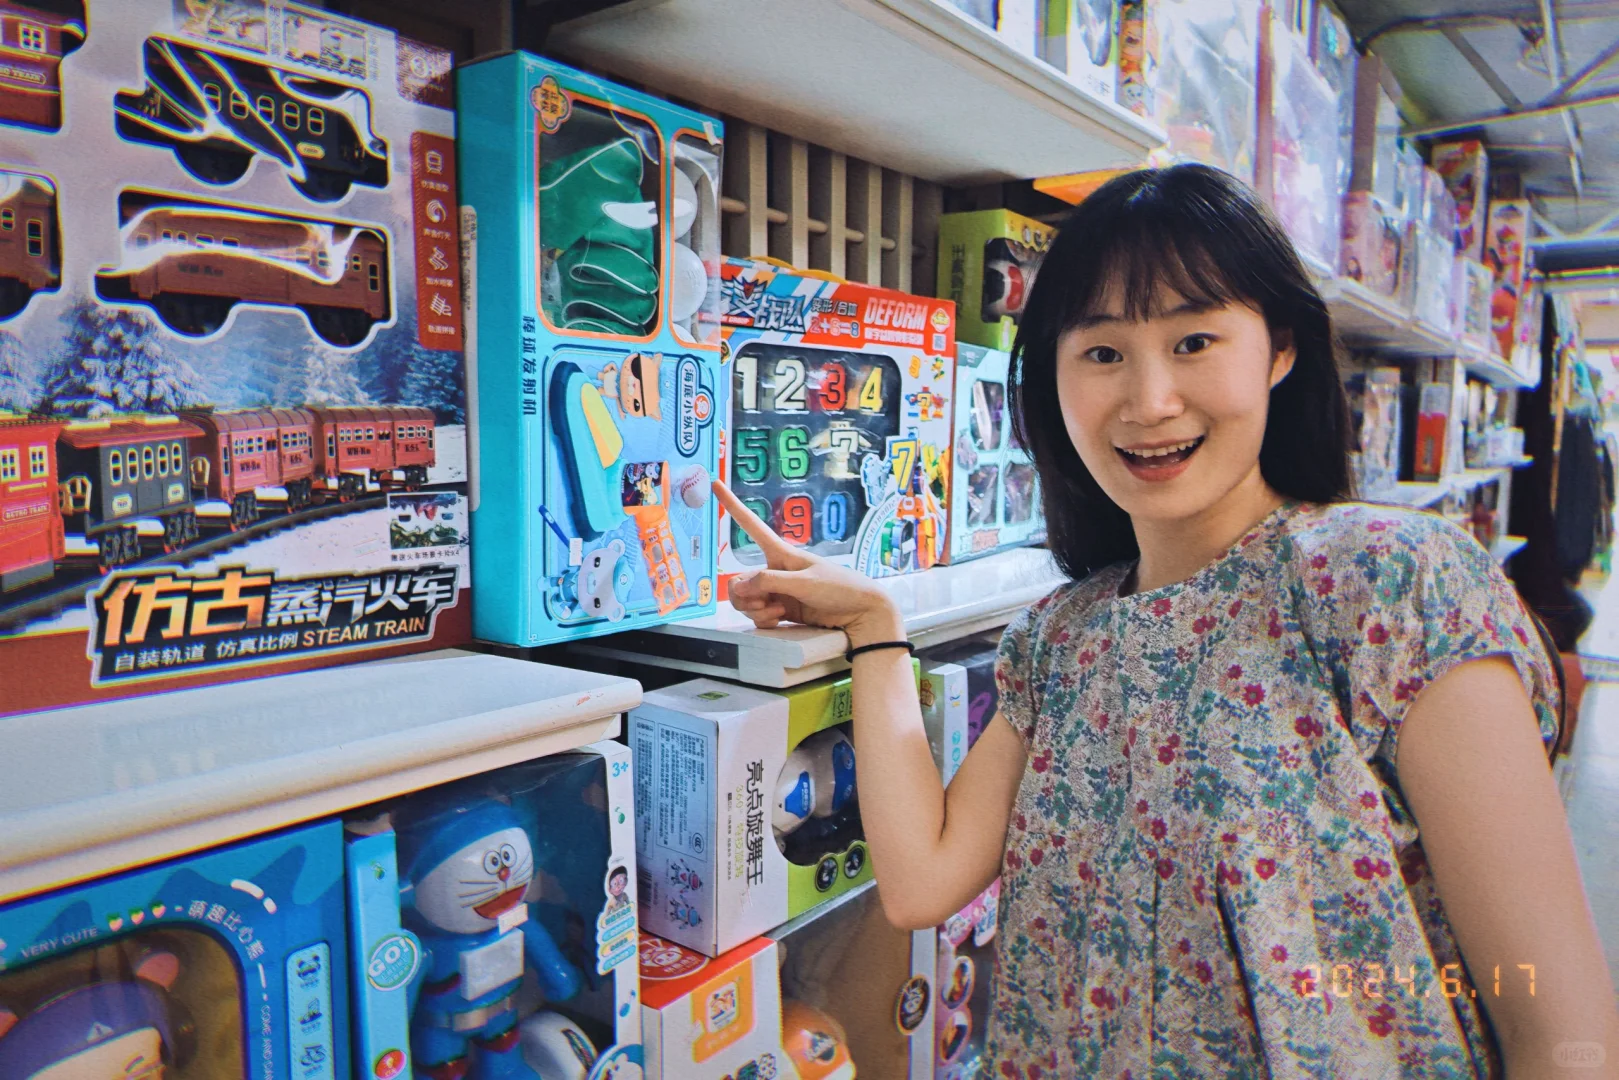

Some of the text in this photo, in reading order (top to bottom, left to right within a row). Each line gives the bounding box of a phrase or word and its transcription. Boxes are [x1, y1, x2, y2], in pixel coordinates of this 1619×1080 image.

[864, 297, 928, 331] DEFORM
[522, 315, 537, 416] 棒球发射机
[736, 357, 884, 413] 1 2 3 4
[683, 368, 694, 445] 海底小纵队
[737, 429, 770, 483] 5
[779, 428, 809, 480] 6
[889, 438, 918, 495] 7
[6, 504, 48, 520] RETRO TRAIN
[782, 496, 812, 545] 9
[822, 493, 848, 543] 0
[103, 571, 454, 646] 仿古蒸汽火车
[115, 616, 426, 673] 自装轨道 仿真比例 STEAM TRAIN
[612, 760, 630, 777] 3+
[746, 758, 765, 887] 亮点旋舞王
[20, 926, 98, 958] VERY CUTE
[368, 939, 410, 978] GO!
[261, 1004, 273, 1037] COME
[262, 1038, 273, 1060] AND
